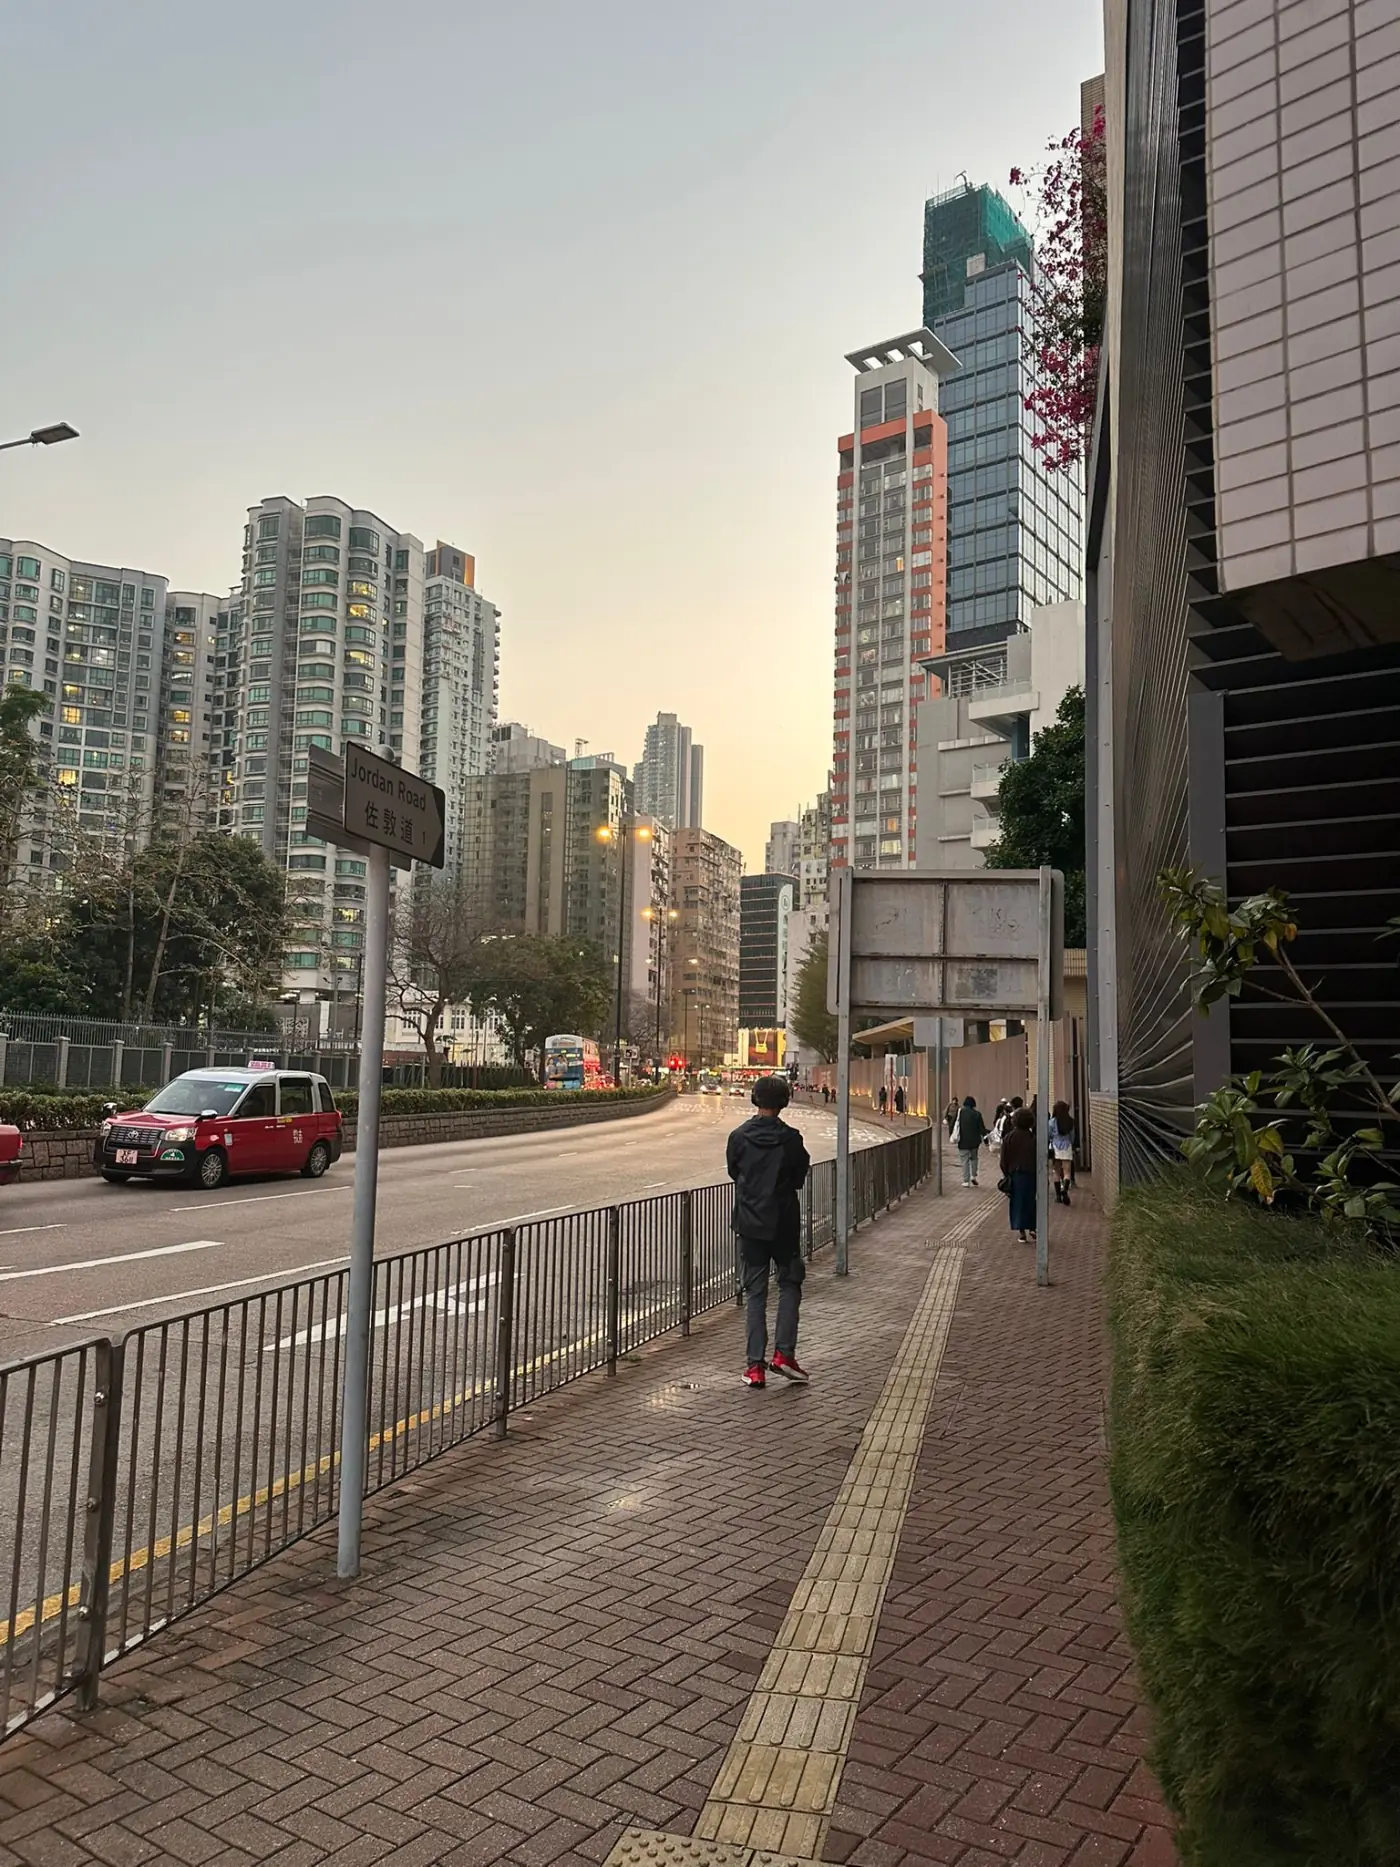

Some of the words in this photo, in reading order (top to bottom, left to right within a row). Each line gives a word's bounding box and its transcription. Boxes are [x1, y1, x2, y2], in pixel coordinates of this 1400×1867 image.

[351, 757, 394, 796] Jordan
[398, 780, 427, 811] Road
[364, 800, 414, 845] 佐敦道
